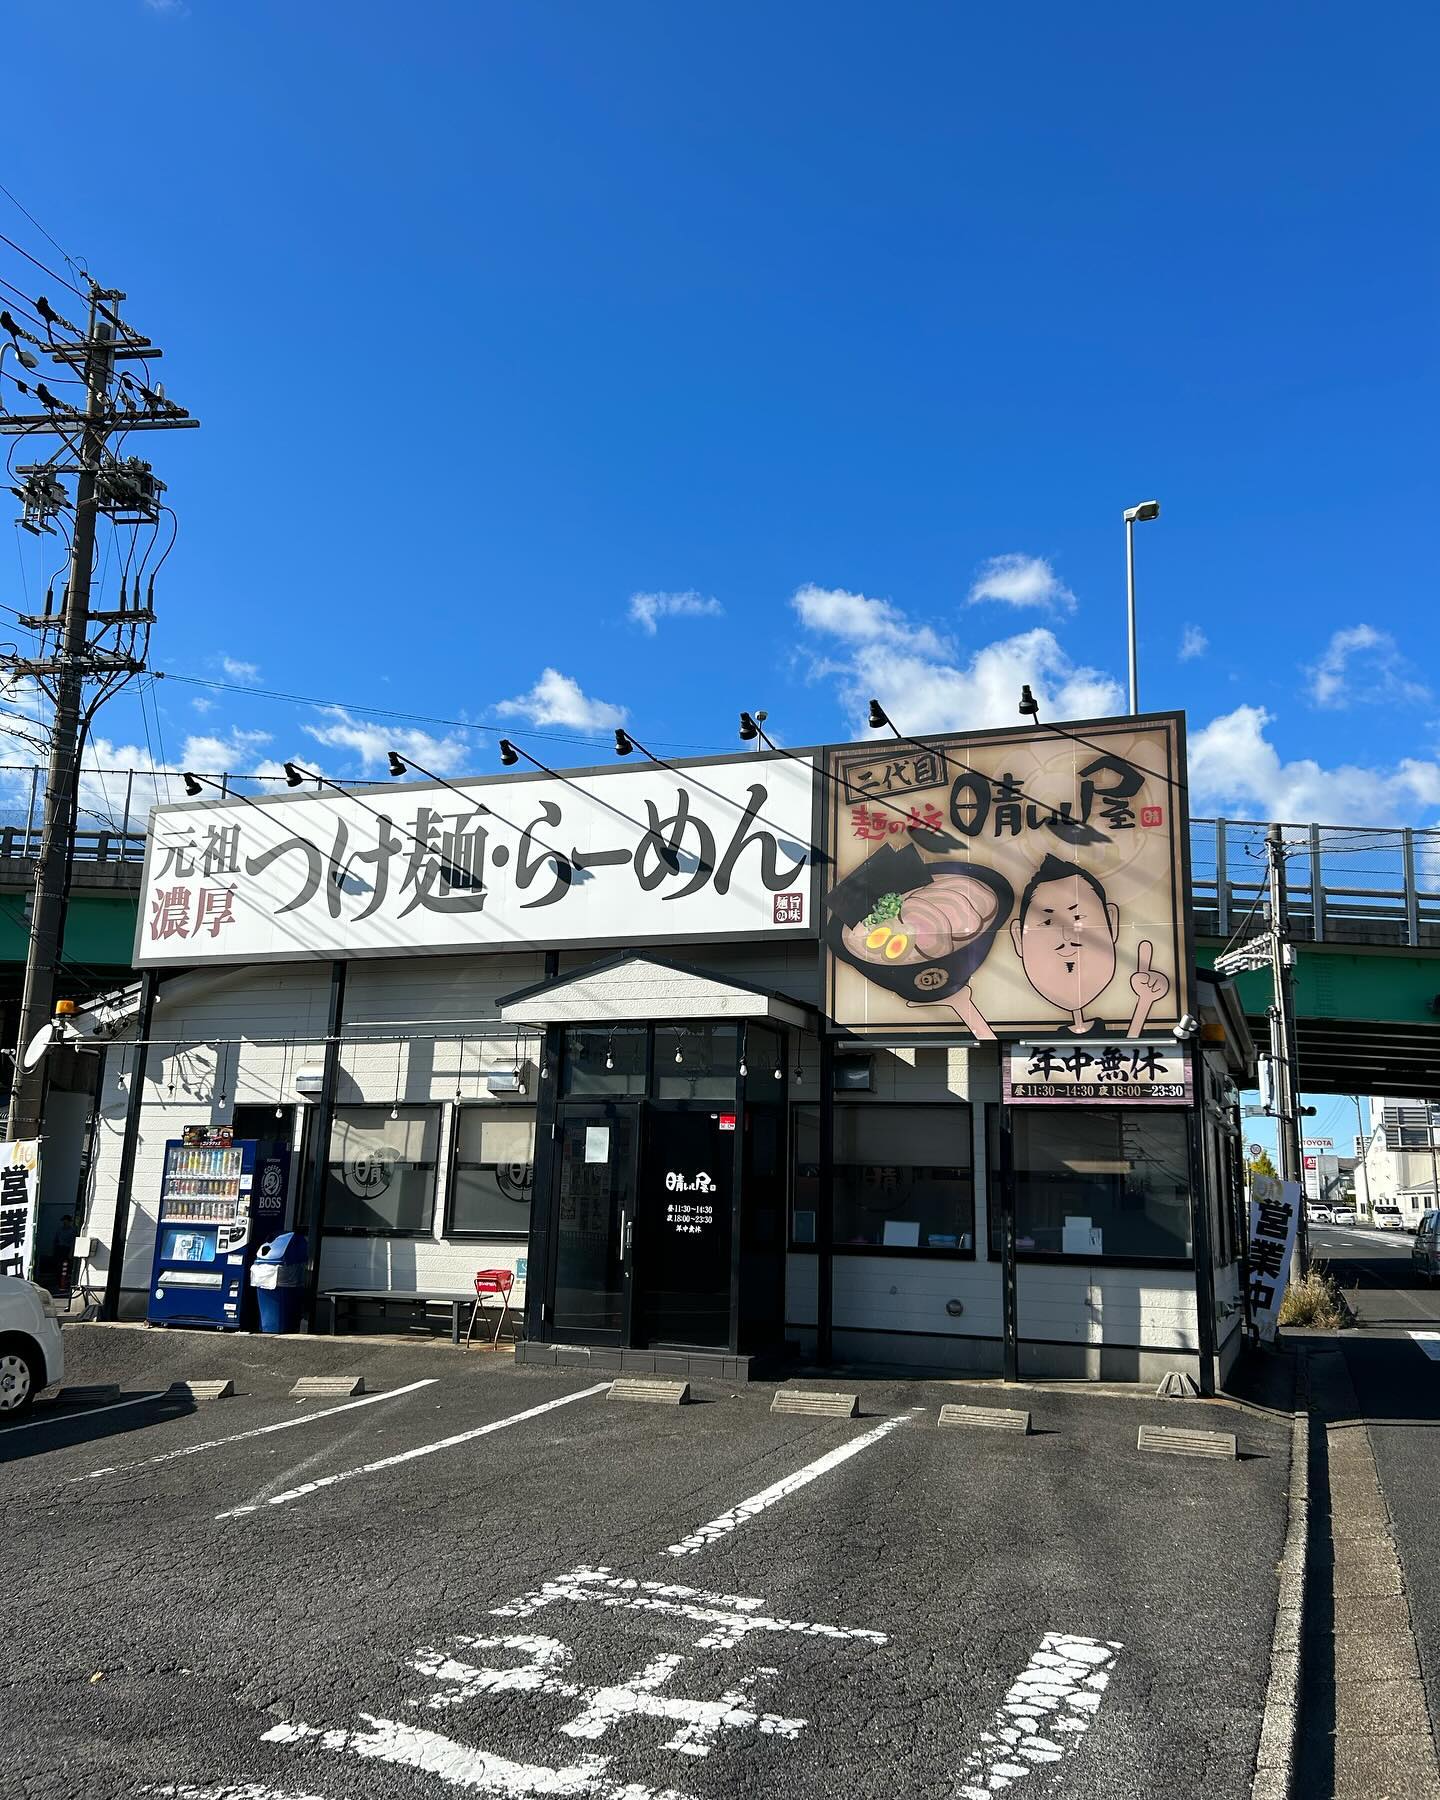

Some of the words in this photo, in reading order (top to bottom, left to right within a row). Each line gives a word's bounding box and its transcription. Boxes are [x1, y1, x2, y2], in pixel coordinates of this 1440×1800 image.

[857, 754, 938, 791] 二代目
[851, 803, 943, 840] 麺の坊
[154, 823, 242, 880] 元祖
[150, 882, 238, 940] 濃厚
[1028, 1046, 1168, 1082] 年中無休
[259, 1197, 281, 1208] BOSS
[1249, 1199, 1293, 1317] 営業中
